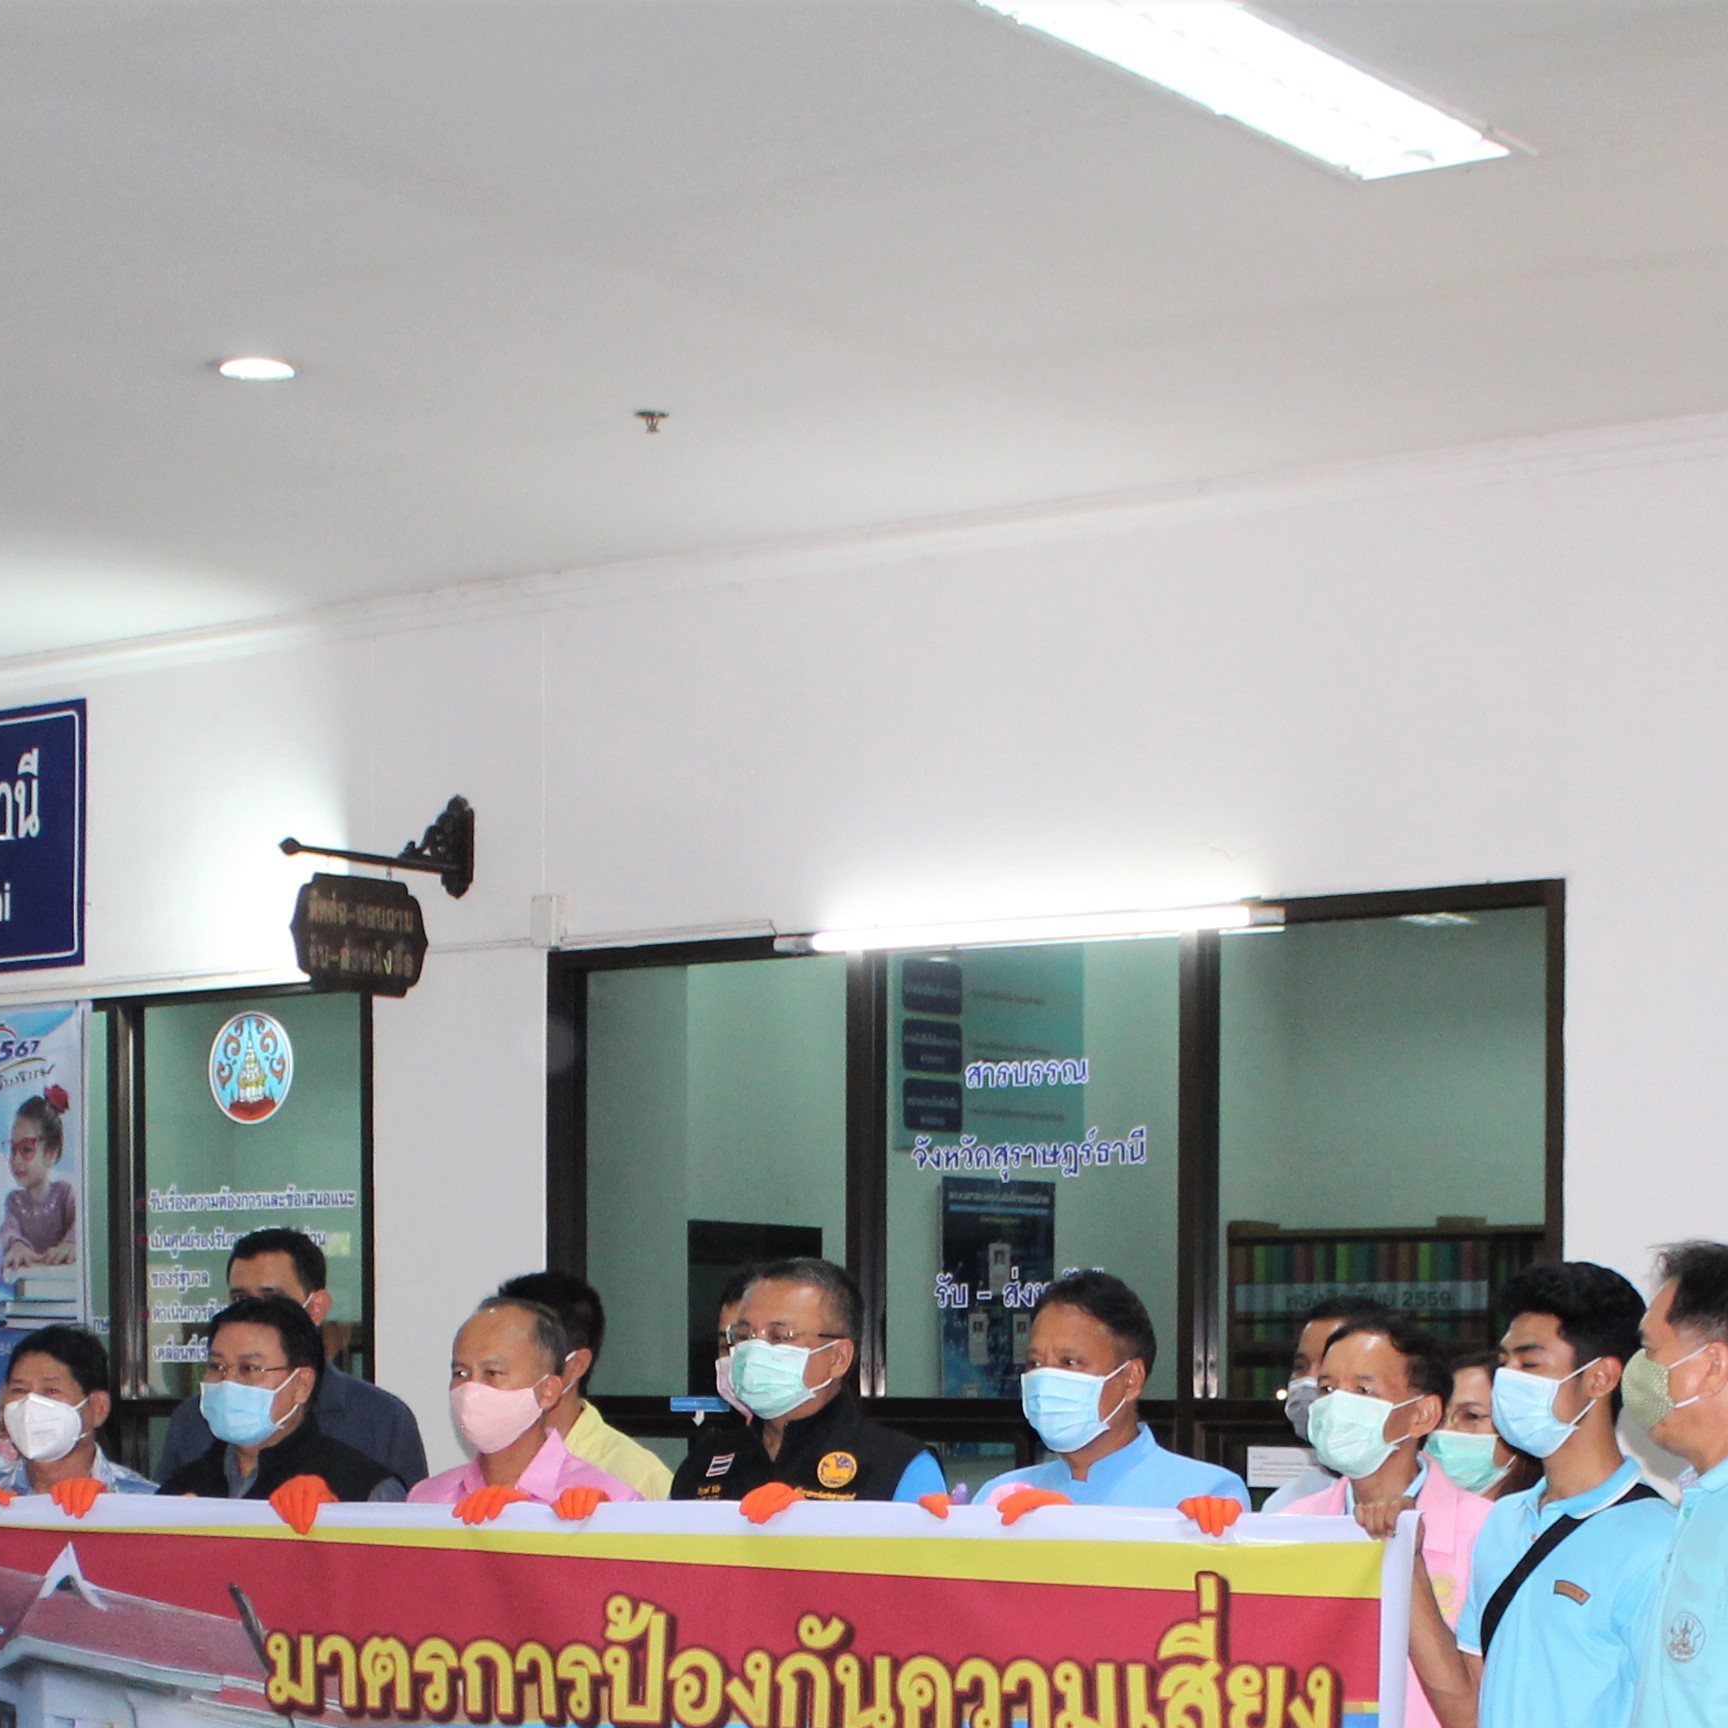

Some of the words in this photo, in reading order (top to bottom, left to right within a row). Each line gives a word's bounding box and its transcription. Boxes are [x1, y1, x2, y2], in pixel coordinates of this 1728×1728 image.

[965, 1058, 1090, 1089] สารบรรณ
[911, 1126, 1148, 1183] จังหวัดสุราษฎร์ธานี
[934, 1273, 969, 1308] รับ
